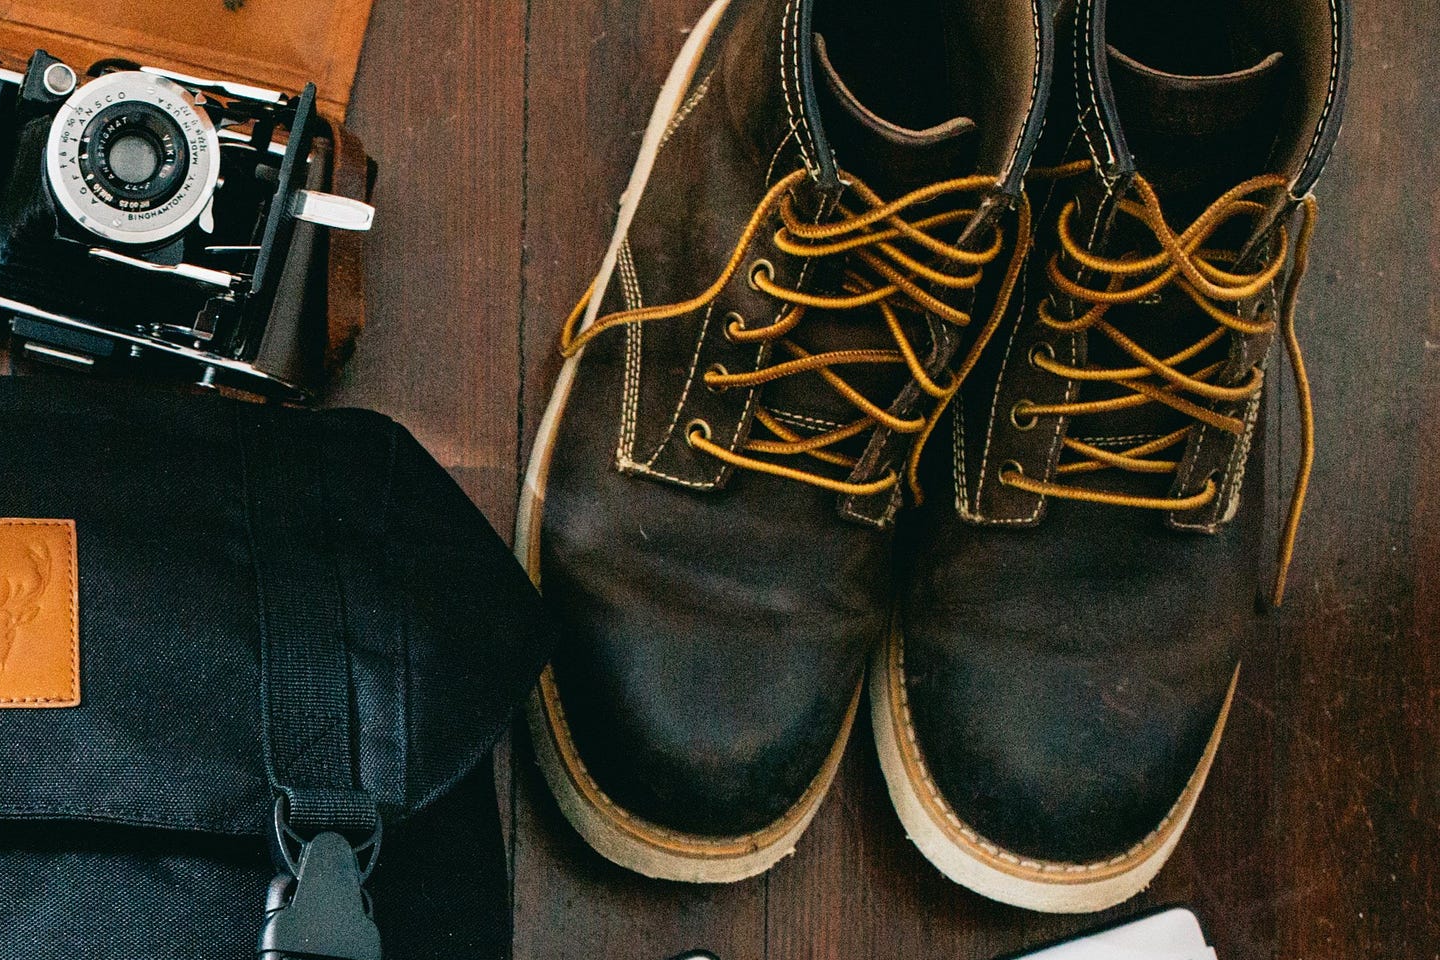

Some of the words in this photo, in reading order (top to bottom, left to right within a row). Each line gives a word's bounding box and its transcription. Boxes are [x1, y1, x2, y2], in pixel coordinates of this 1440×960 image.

[79, 91, 127, 126] ANSCO
[190, 139, 199, 165] MADE
[69, 157, 99, 206] AGFA
